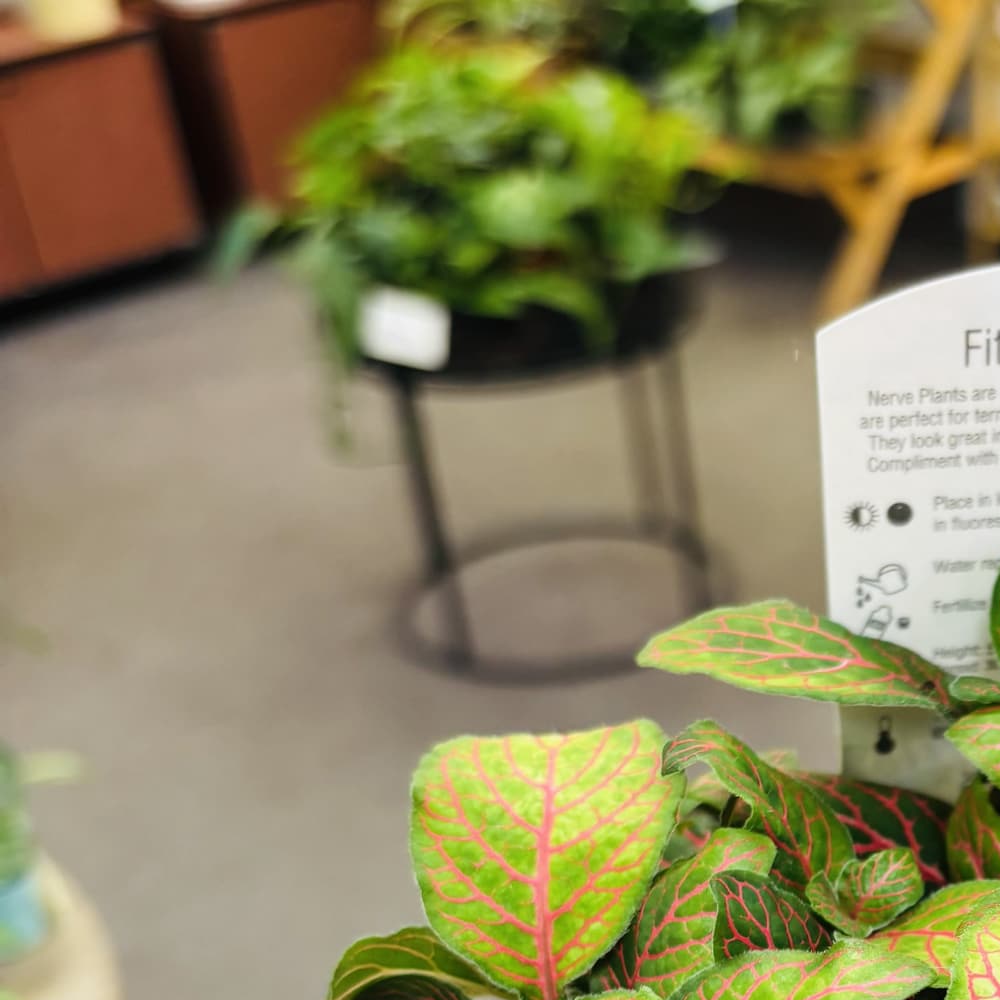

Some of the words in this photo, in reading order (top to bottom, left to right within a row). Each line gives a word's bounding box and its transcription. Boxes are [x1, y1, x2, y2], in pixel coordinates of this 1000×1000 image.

[867, 389, 914, 407] Nerve
[918, 386, 968, 405] Plants
[971, 388, 997, 402] are
[859, 415, 884, 430] are
[888, 410, 943, 431] perfect
[947, 409, 970, 425] for
[867, 434, 907, 453] They
[911, 432, 945, 449] look
[948, 431, 988, 450] great
[867, 454, 962, 476] Compliment
[965, 450, 999, 467] with
[933, 495, 974, 511] Place
[978, 491, 992, 507] in
[933, 517, 947, 532] in
[932, 559, 977, 574] Water
